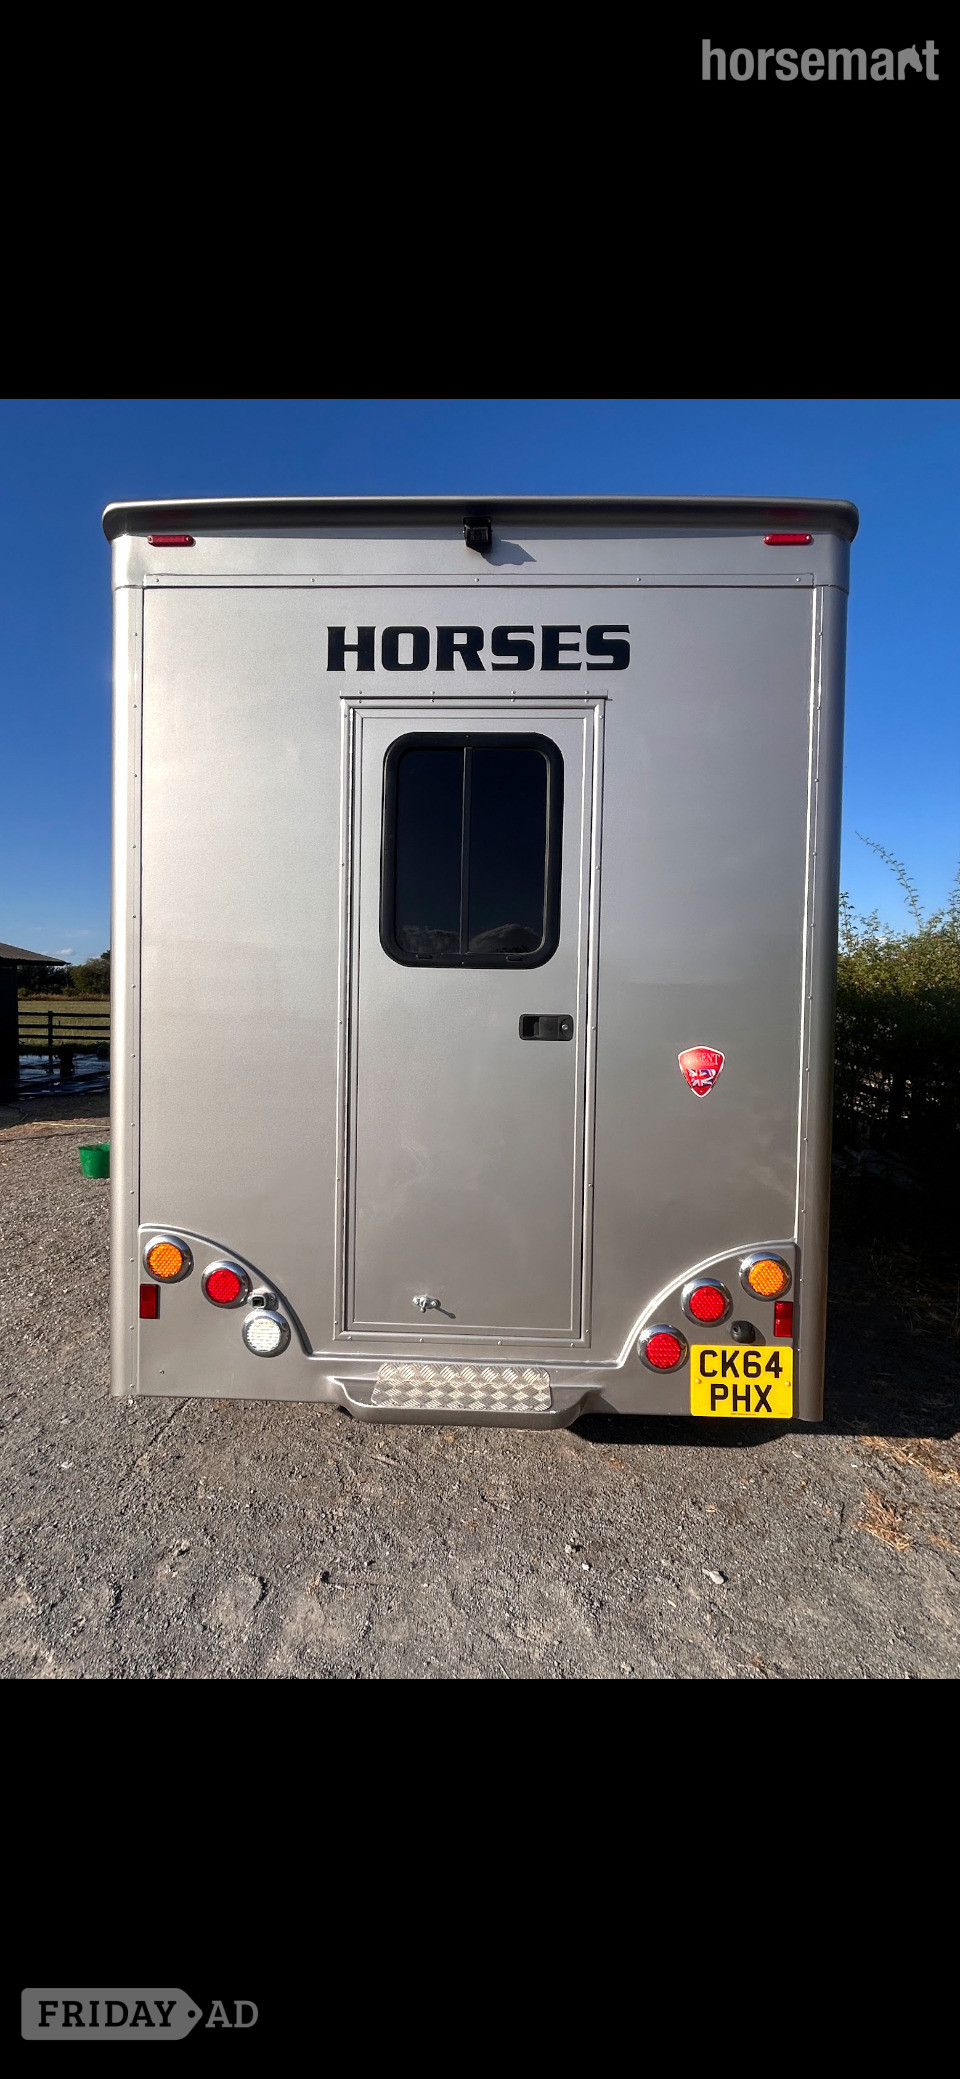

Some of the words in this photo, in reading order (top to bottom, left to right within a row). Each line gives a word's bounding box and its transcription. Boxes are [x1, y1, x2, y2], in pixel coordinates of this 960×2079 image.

[326, 624, 631, 672] HORSES
[699, 1350, 783, 1379] CK64
[710, 1383, 773, 1413] PHX
